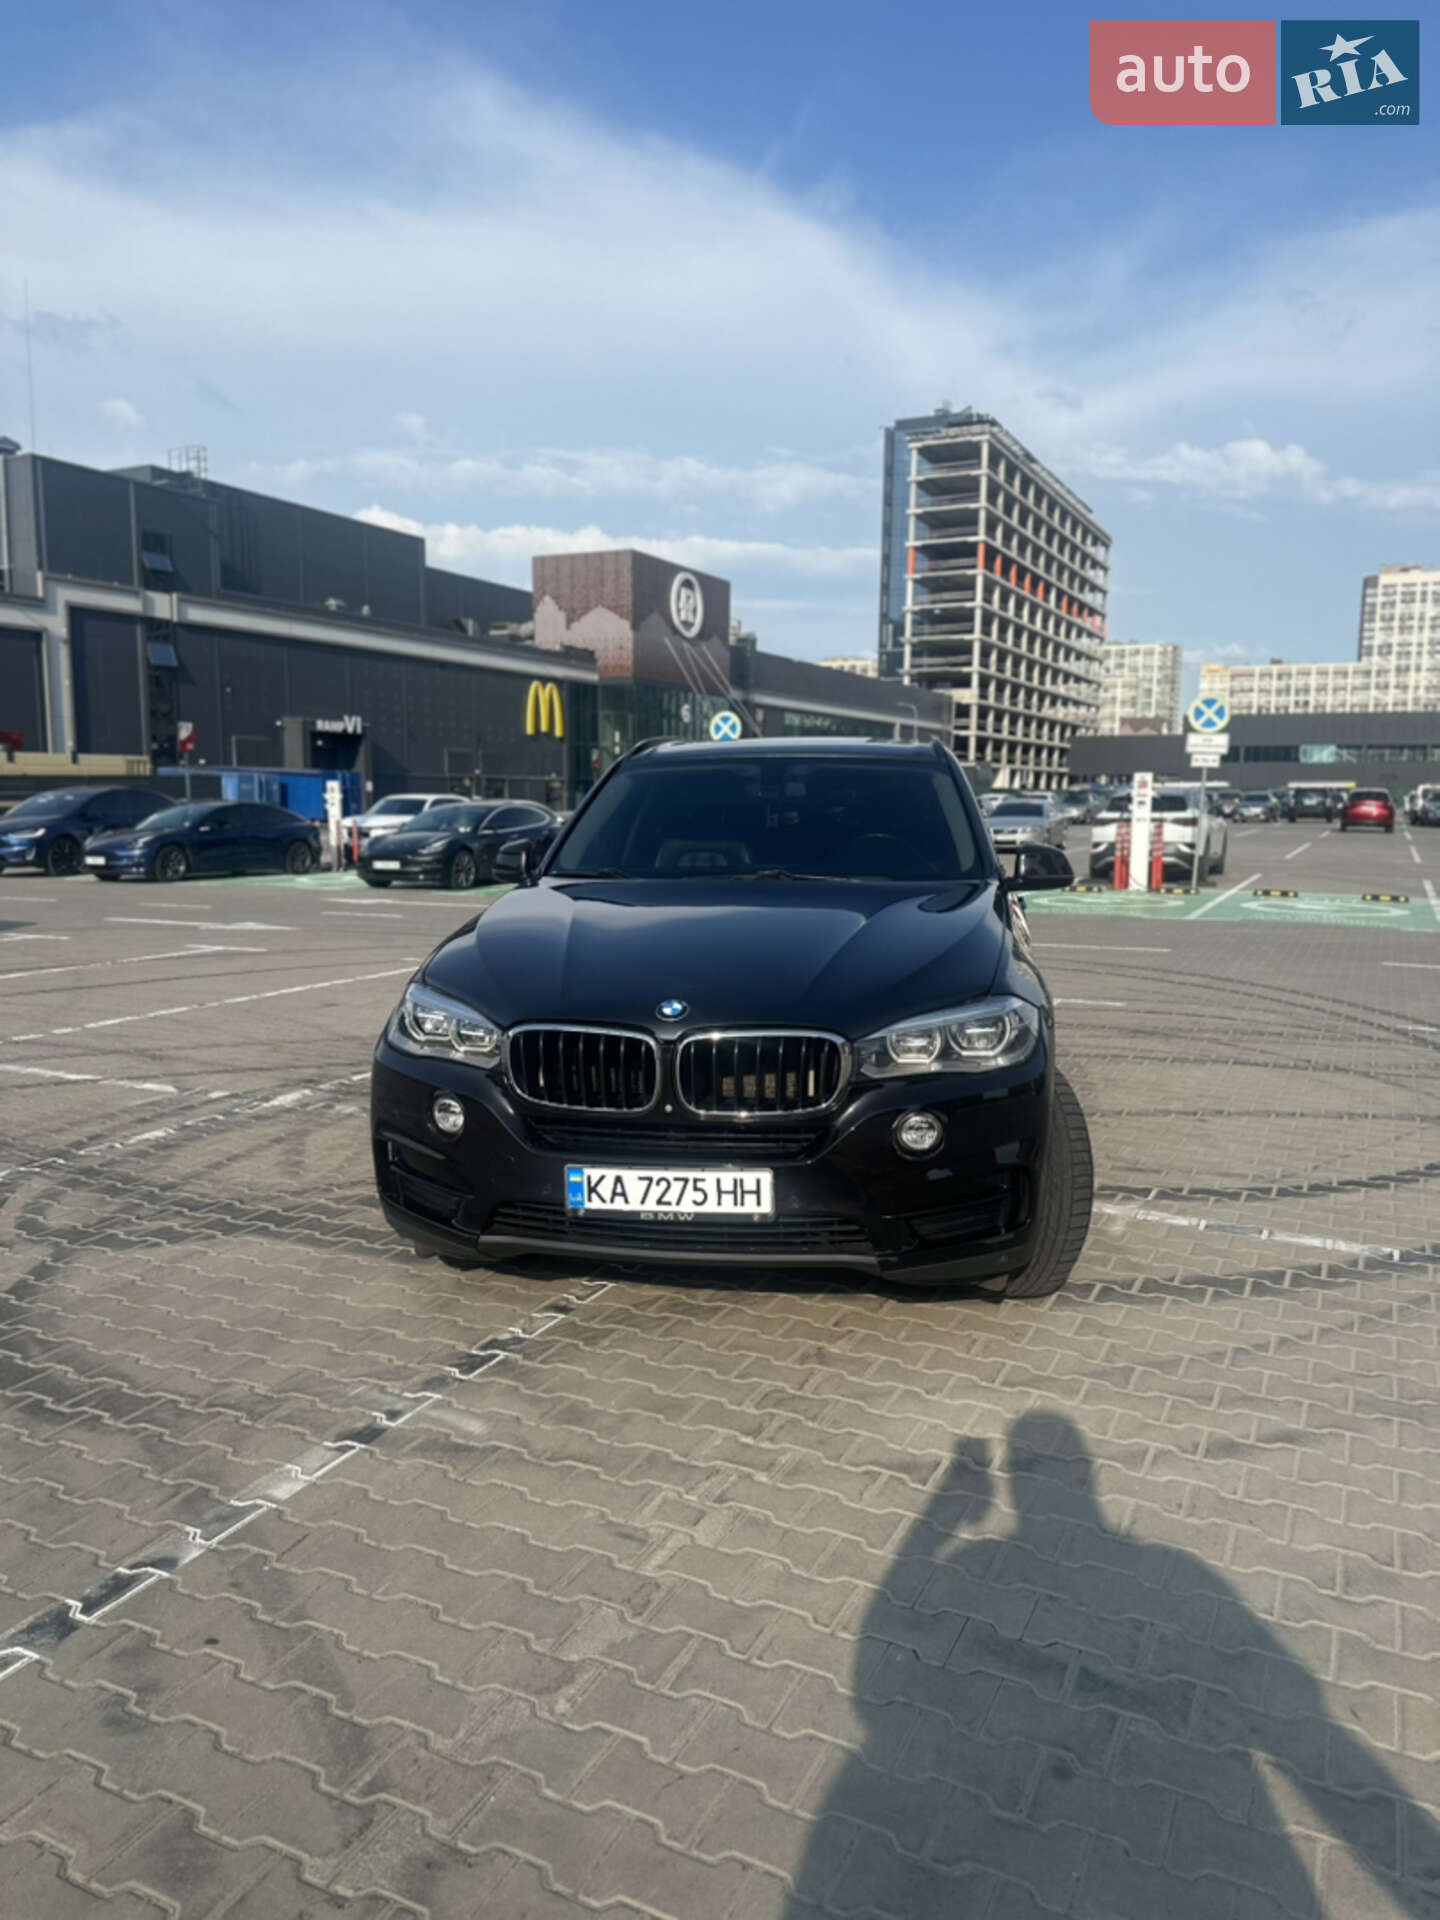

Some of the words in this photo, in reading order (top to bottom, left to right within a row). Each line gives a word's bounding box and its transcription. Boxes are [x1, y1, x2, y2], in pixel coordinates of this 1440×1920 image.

[587, 1174, 630, 1205] KA
[637, 1176, 708, 1207] 7275
[716, 1177, 762, 1208] HH
[640, 1211, 695, 1221] BMW
